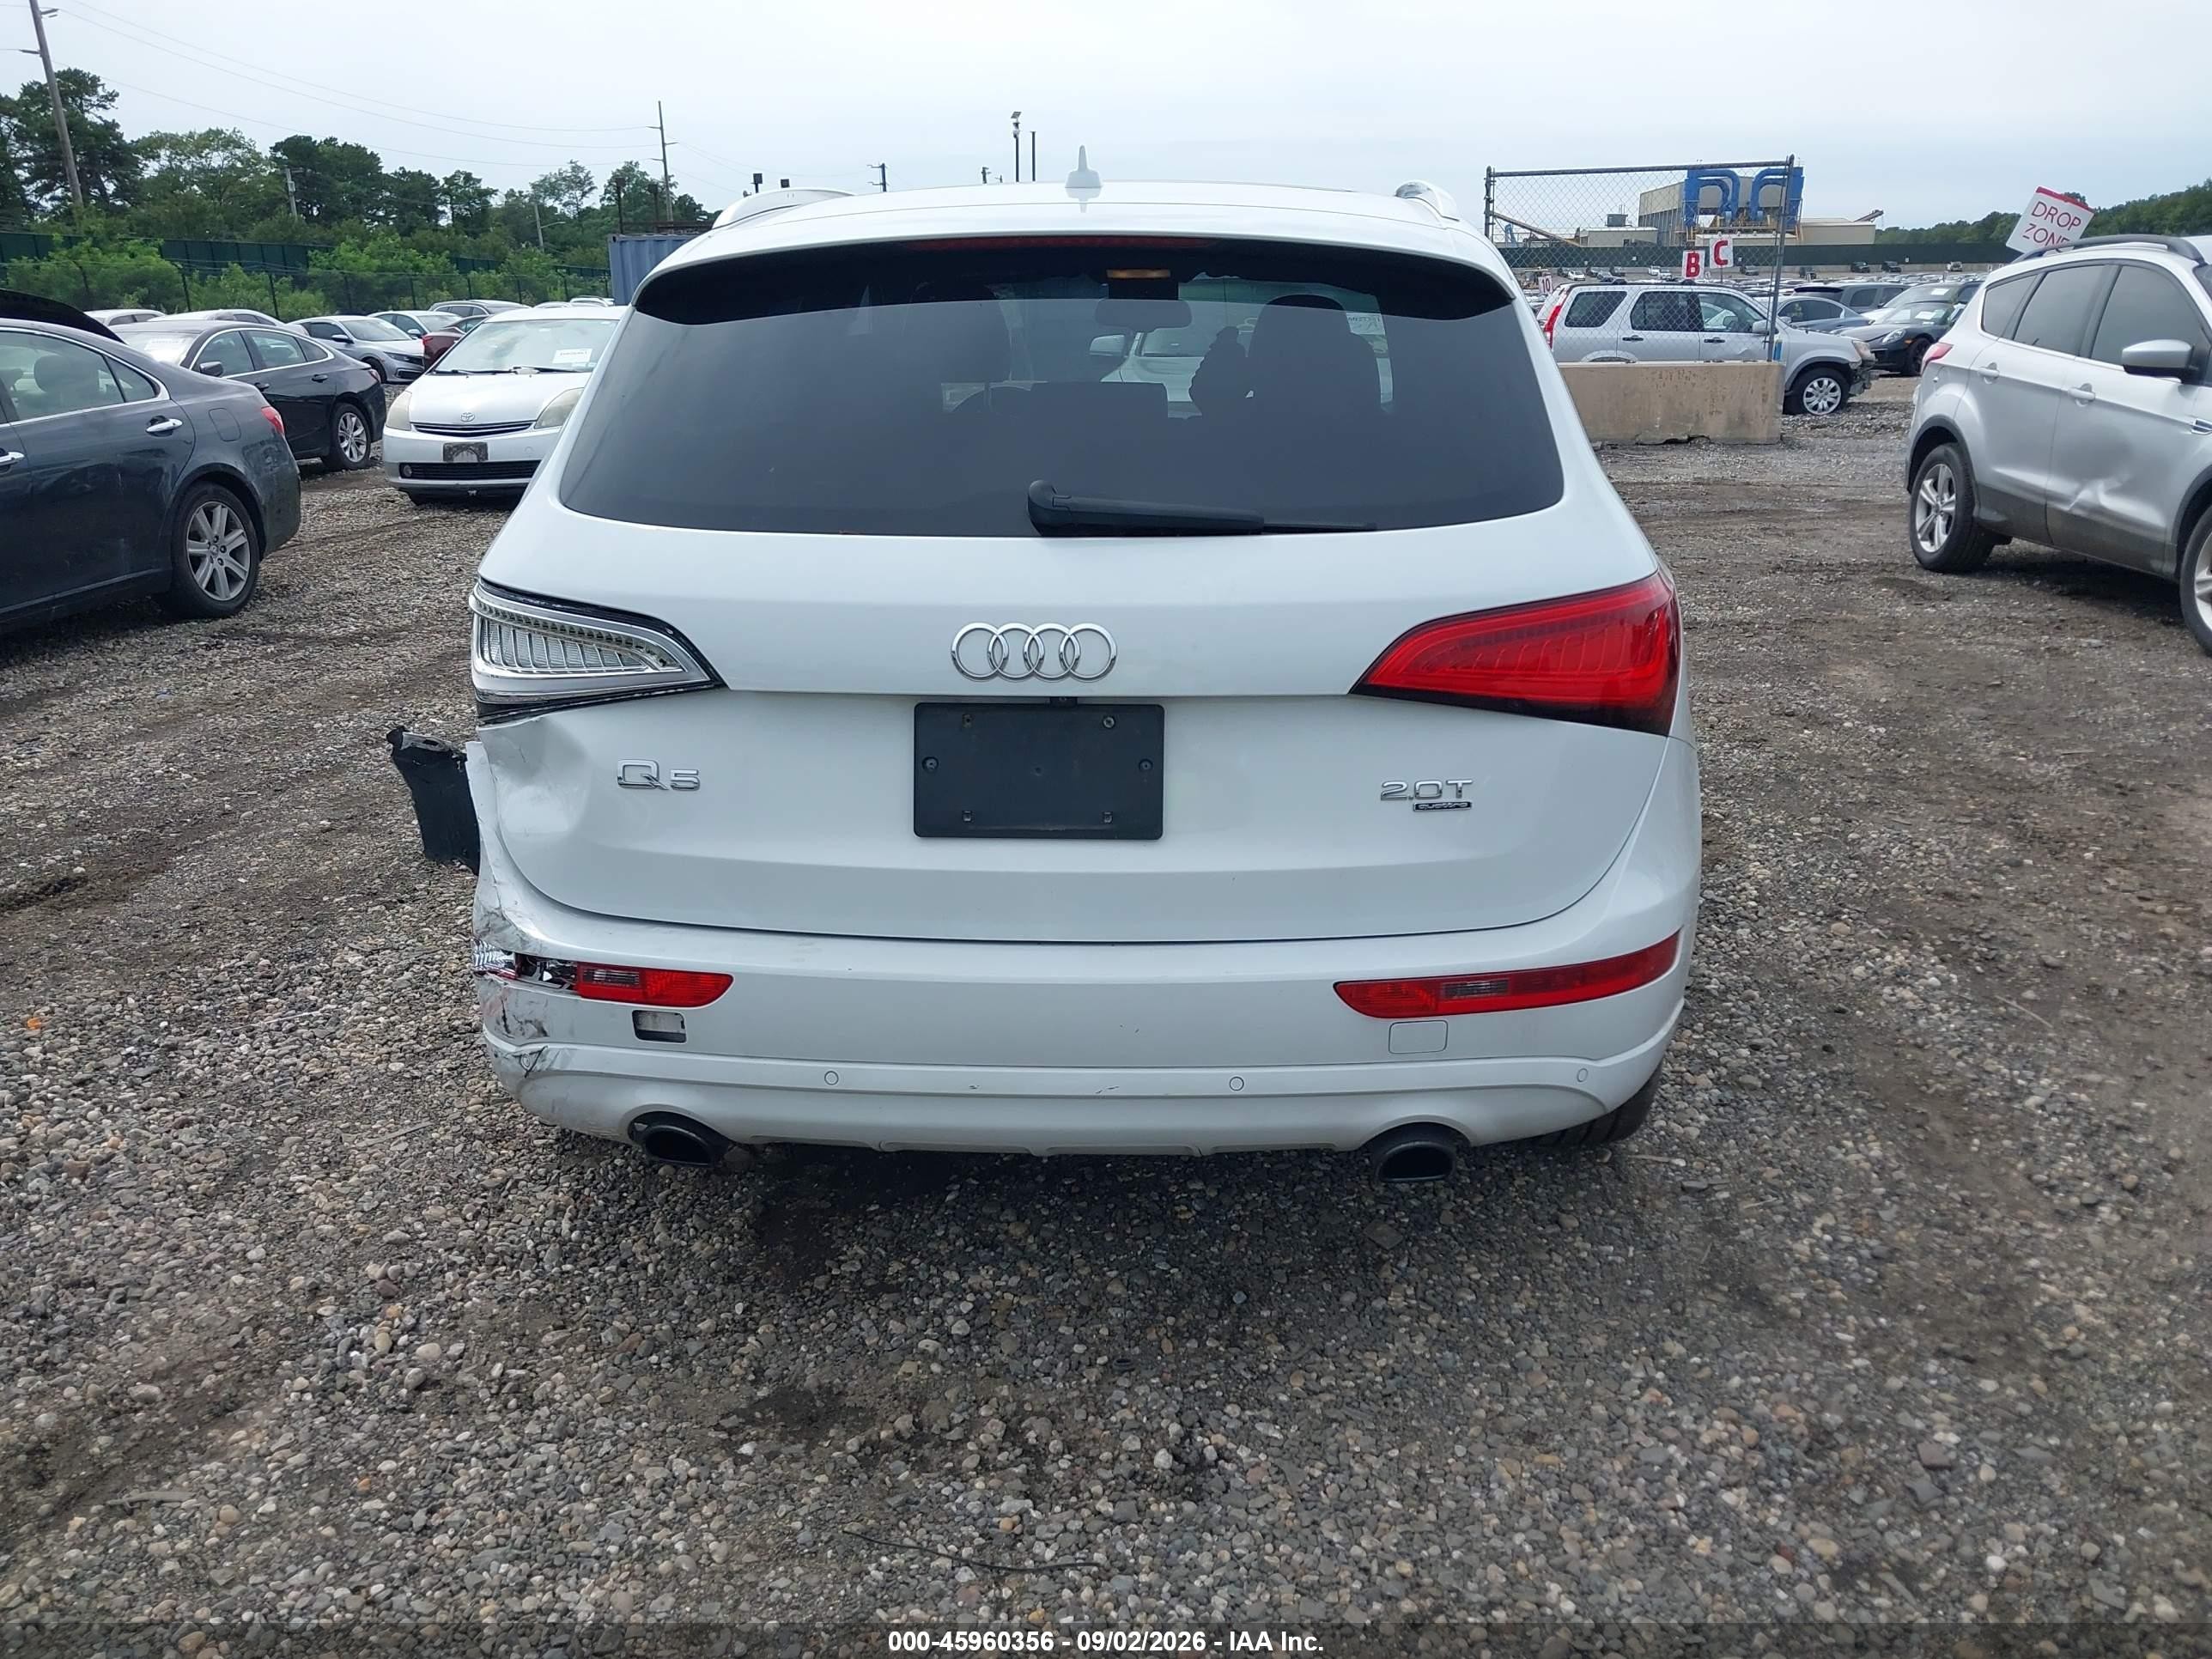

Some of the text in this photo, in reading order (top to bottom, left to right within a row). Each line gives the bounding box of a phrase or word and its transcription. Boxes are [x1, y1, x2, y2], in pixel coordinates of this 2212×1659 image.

[2031, 200, 2081, 232] DROP
[1685, 252, 1700, 278] B
[1713, 240, 1729, 266] C
[1541, 277, 1551, 294] 10
[617, 758, 701, 792] Q5
[1380, 778, 1474, 801] 2.0T
